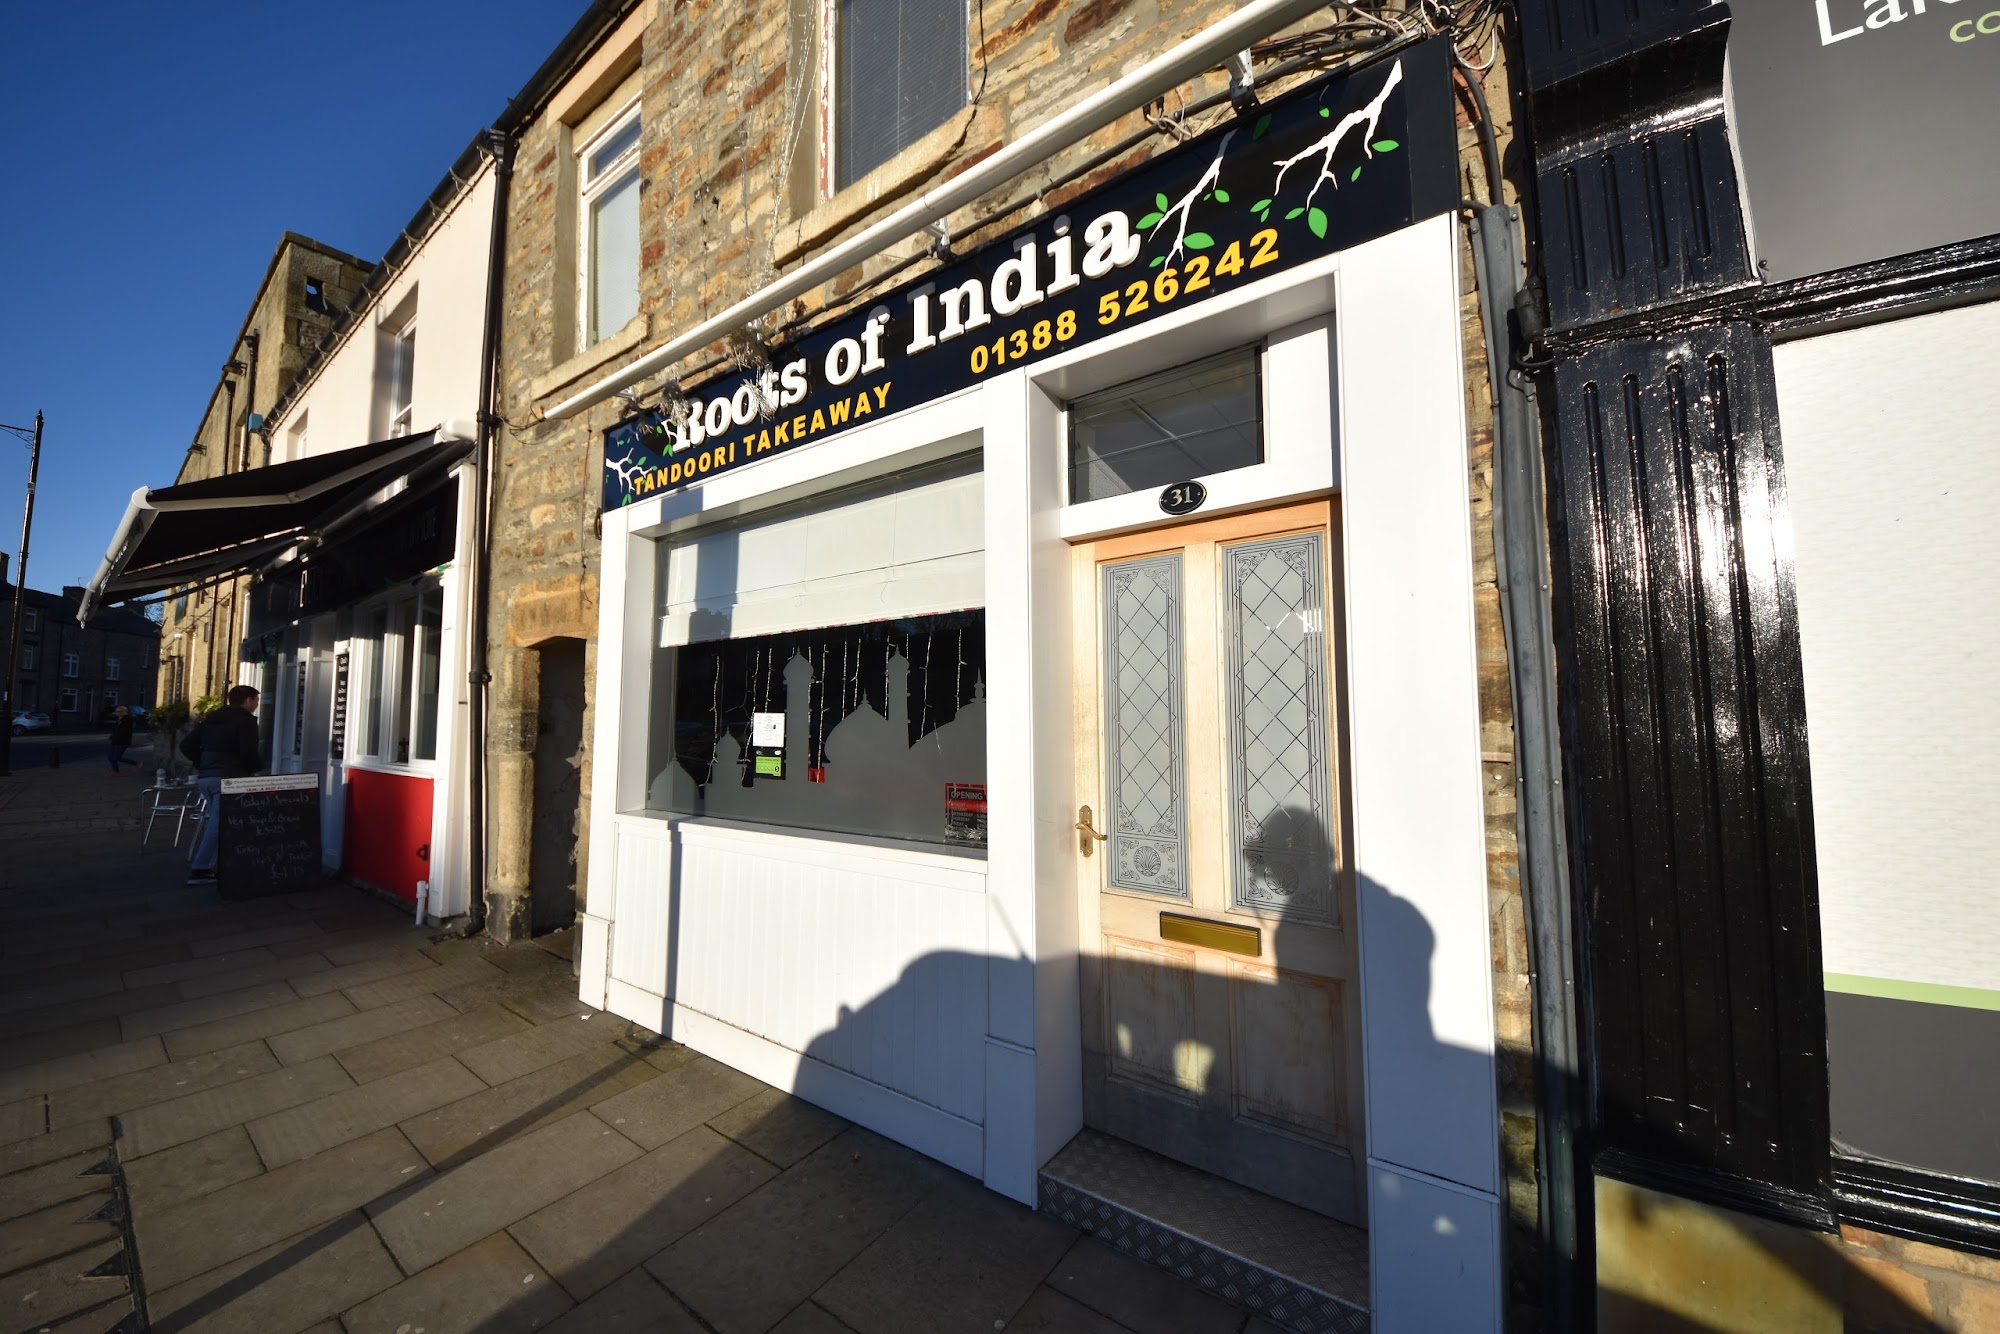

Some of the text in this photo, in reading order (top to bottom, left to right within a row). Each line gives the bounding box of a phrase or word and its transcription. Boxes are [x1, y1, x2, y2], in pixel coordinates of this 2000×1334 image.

[672, 210, 1141, 453] Roots of India
[970, 228, 1279, 374] 01388 526242
[634, 382, 892, 496] TANDOORI TAKEAWAY
[1170, 486, 1193, 507] 31
[951, 791, 983, 801] OPENING
